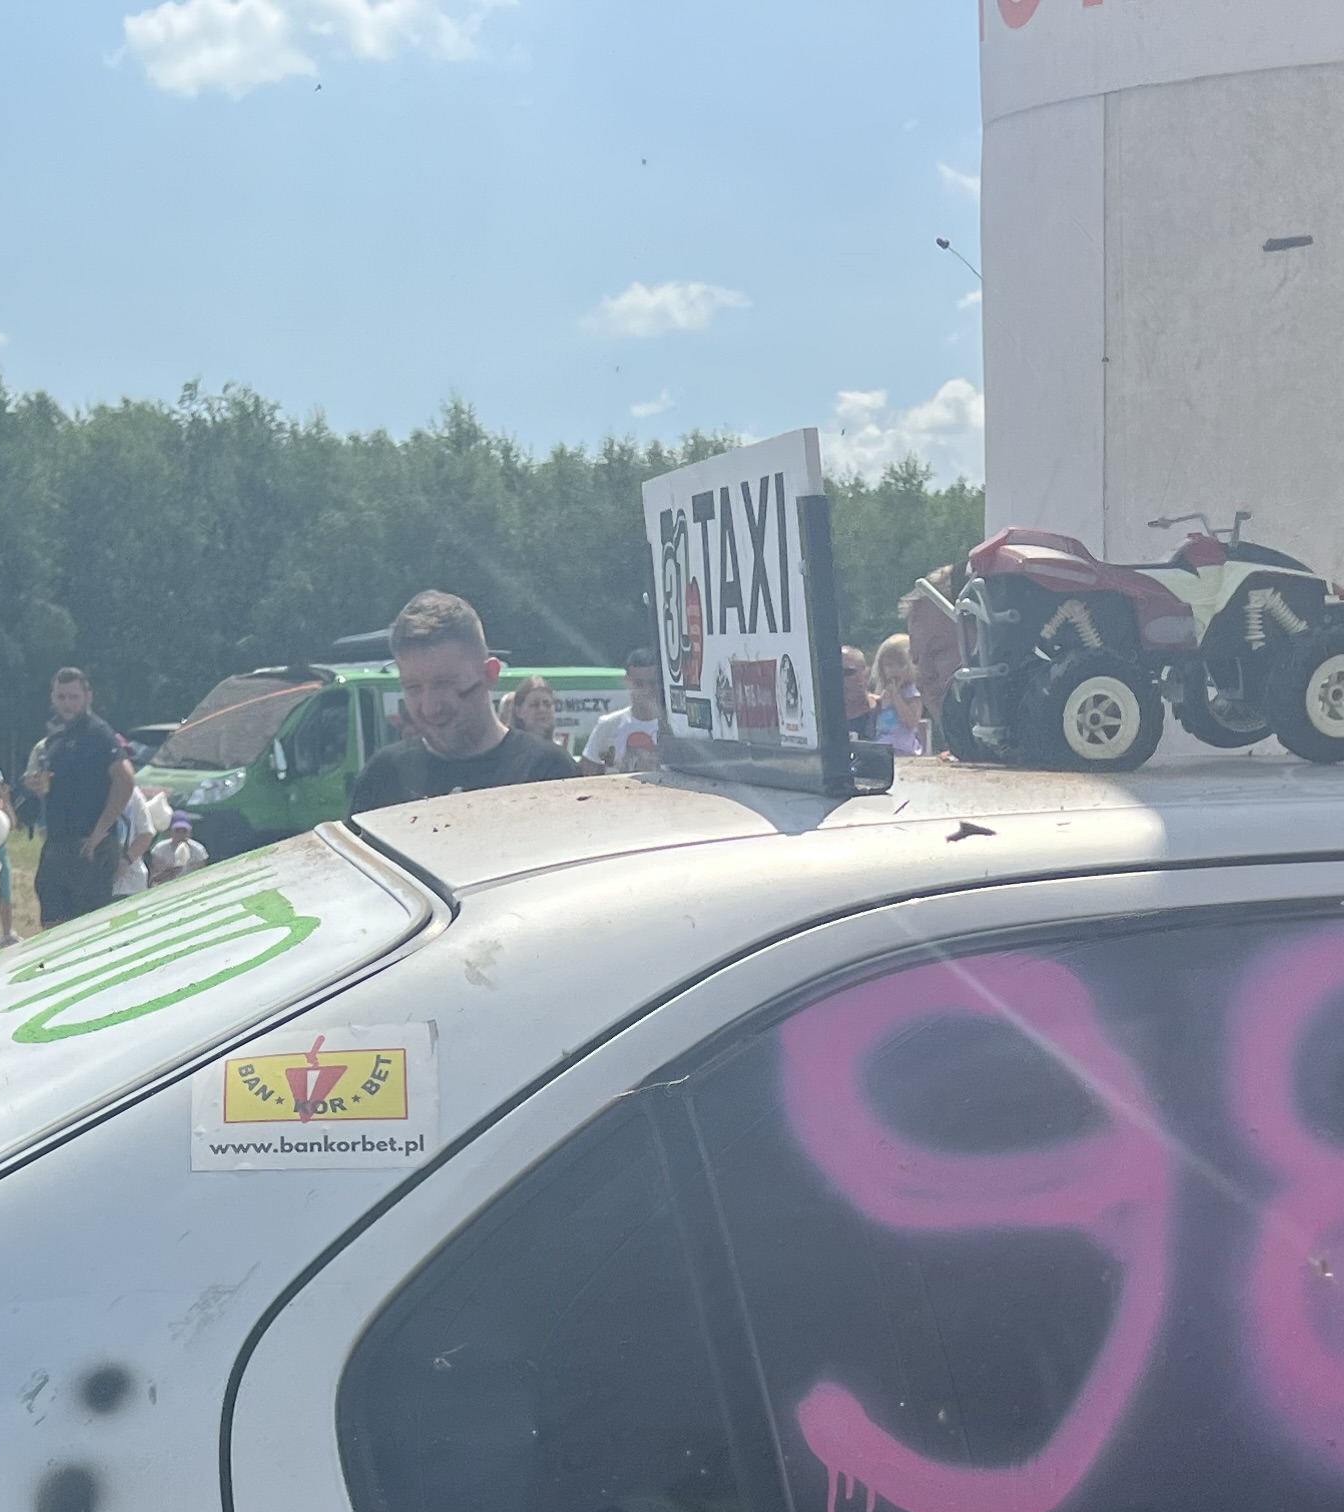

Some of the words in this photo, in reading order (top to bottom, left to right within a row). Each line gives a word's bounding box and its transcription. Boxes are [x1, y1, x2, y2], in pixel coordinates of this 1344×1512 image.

[692, 472, 791, 635] TAXI
[237, 1063, 275, 1102] BAN
[293, 1097, 348, 1115] KOR
[360, 1054, 392, 1096] BET
[209, 1135, 425, 1157] www.bankorbet.pl
